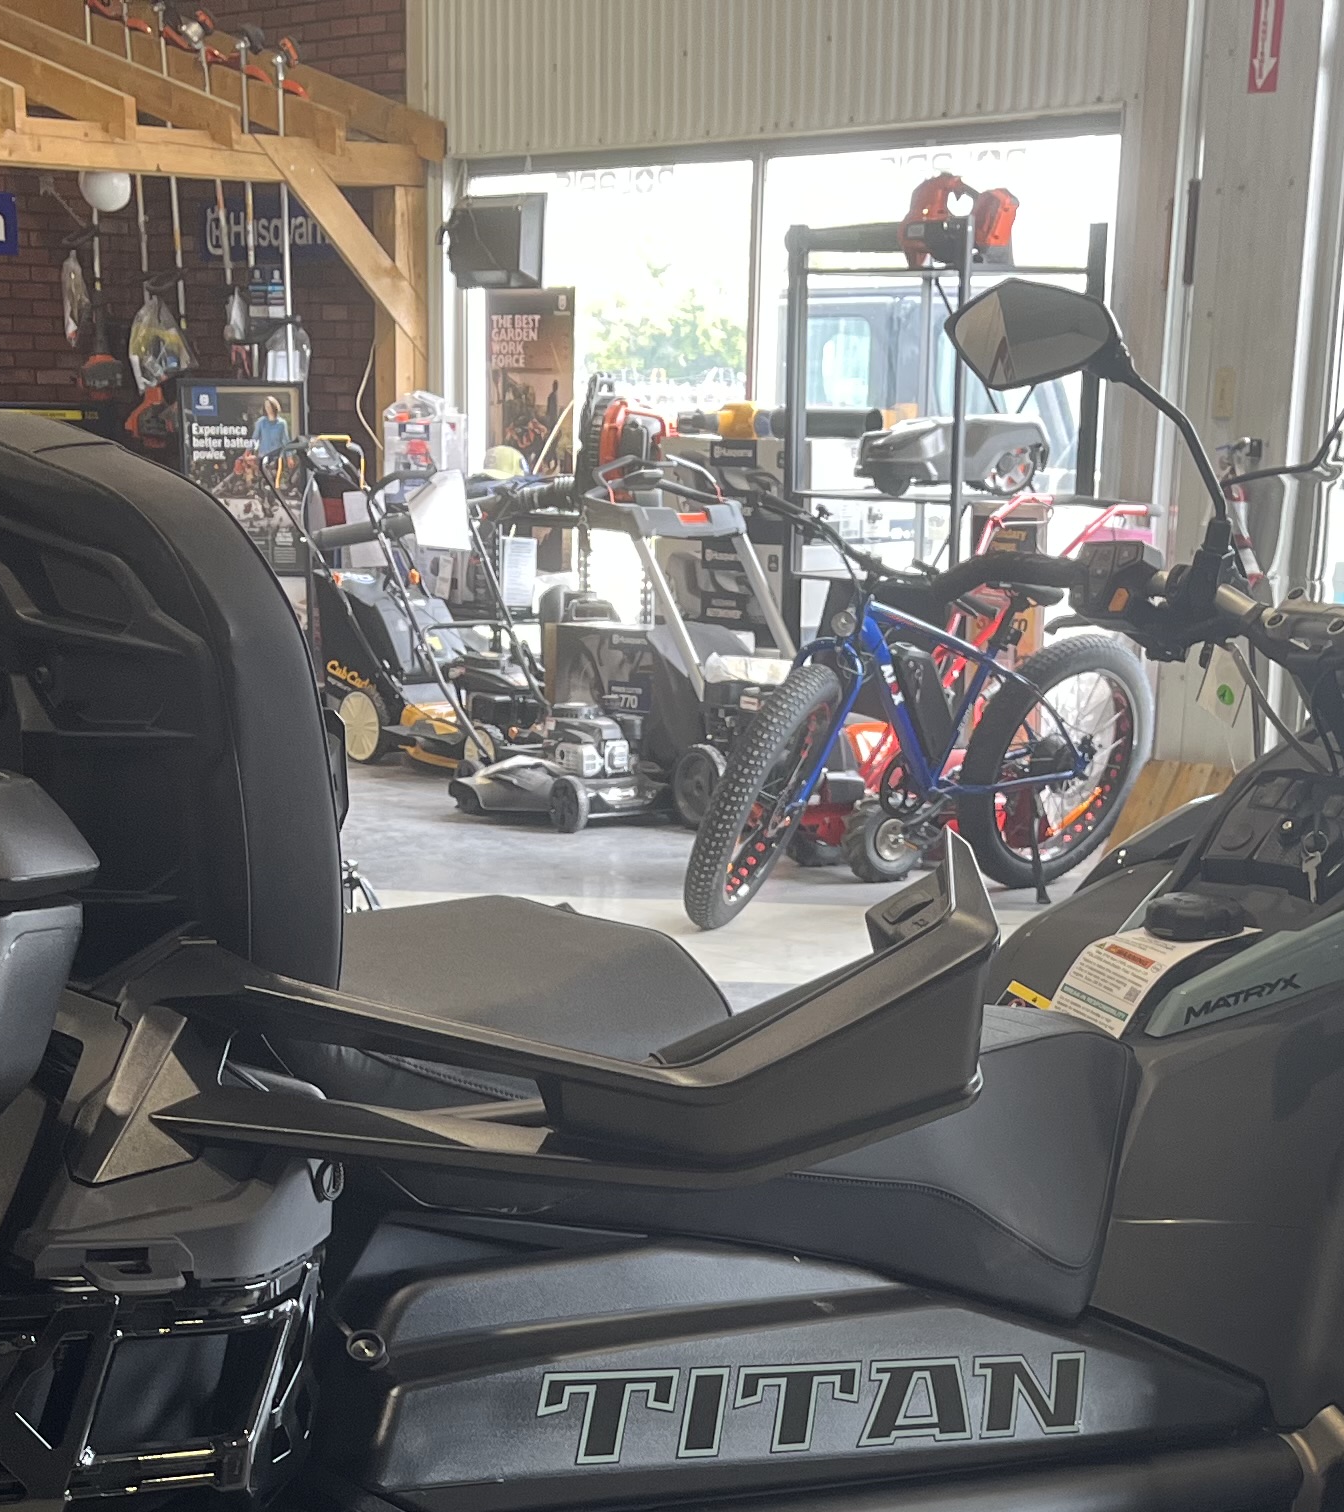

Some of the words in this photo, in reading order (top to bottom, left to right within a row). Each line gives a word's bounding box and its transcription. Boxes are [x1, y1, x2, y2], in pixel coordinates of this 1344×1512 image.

[491, 314, 513, 328] THE
[514, 314, 541, 329] BEST
[491, 328, 538, 342] GARDEN
[491, 341, 524, 355] WORK
[491, 354, 526, 368] FORCE
[192, 423, 248, 436] Experience
[192, 436, 223, 449] better
[224, 436, 260, 450] battery
[193, 449, 226, 461] power.
[619, 693, 639, 709] 770
[1183, 973, 1303, 1026] MATRYX
[536, 1350, 1086, 1466] TITAN
